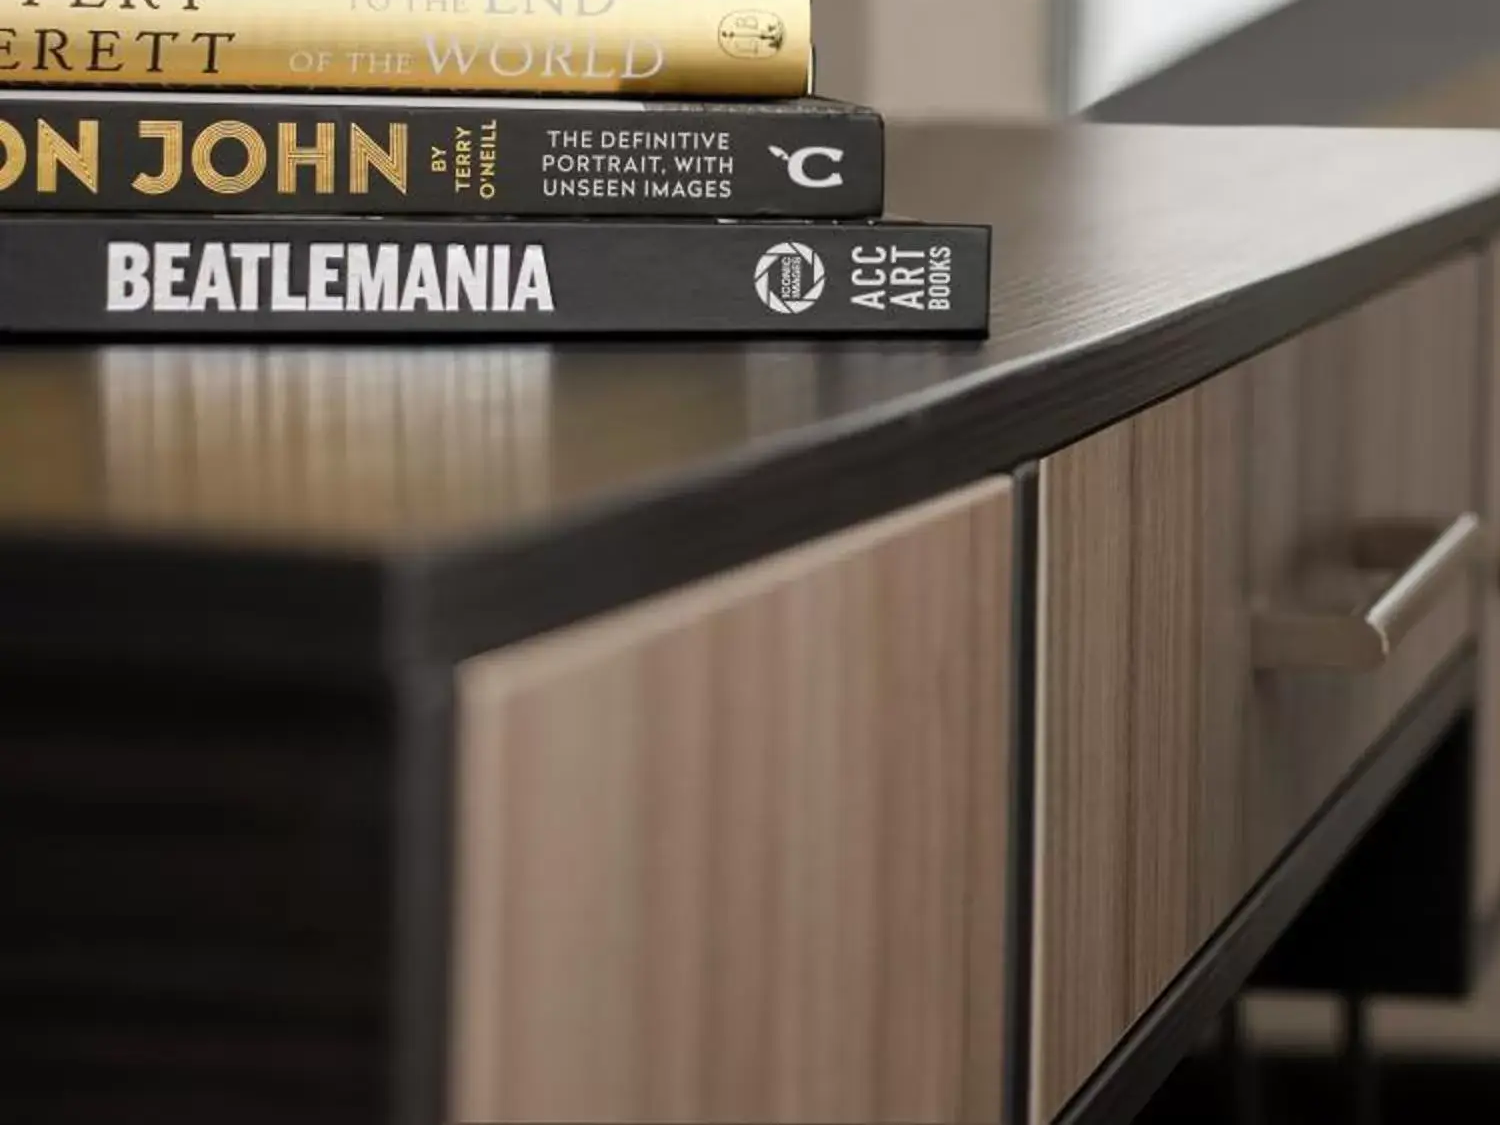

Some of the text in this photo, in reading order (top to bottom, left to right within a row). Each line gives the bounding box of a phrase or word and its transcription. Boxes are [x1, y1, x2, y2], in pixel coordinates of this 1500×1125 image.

[289, 31, 665, 80] OF THE WORLD
[131, 119, 408, 195] JOHN
[431, 146, 447, 172] BY
[455, 126, 472, 193] TERRY
[479, 119, 497, 200] O'NEILL
[542, 155, 734, 175] PORTRAIT, WITH
[547, 130, 730, 151] THE DEFINITIVE
[543, 179, 732, 199] UNSEEN IMAGES
[106, 242, 555, 312] BEATLEMANIA
[850, 245, 887, 311] ACC
[889, 244, 926, 311] ART
[927, 245, 951, 311] BOOKS
